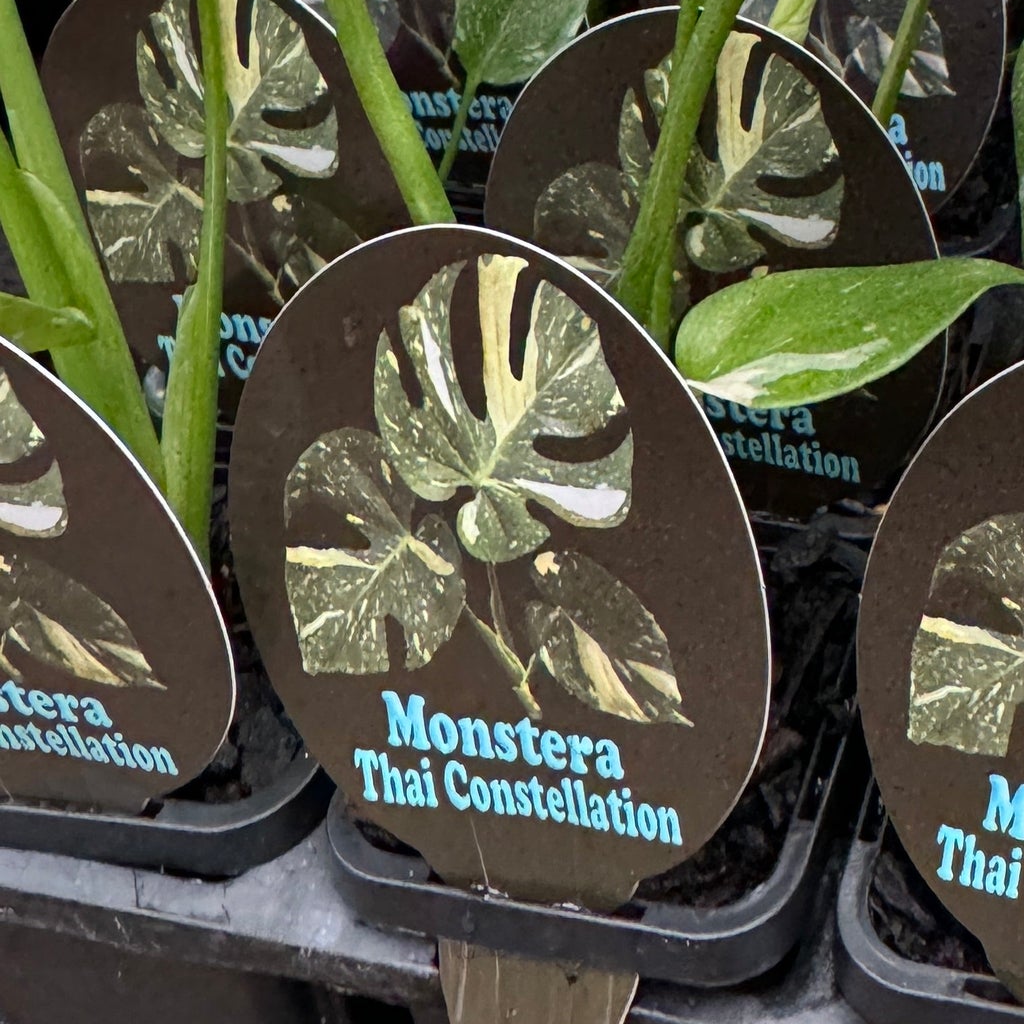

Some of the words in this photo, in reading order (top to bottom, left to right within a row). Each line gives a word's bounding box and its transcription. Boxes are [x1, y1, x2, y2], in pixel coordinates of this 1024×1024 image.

[381, 690, 625, 780] Monstera
[354, 748, 438, 808] Thai
[444, 760, 683, 846] Constellation
[937, 824, 1022, 899] Thai
